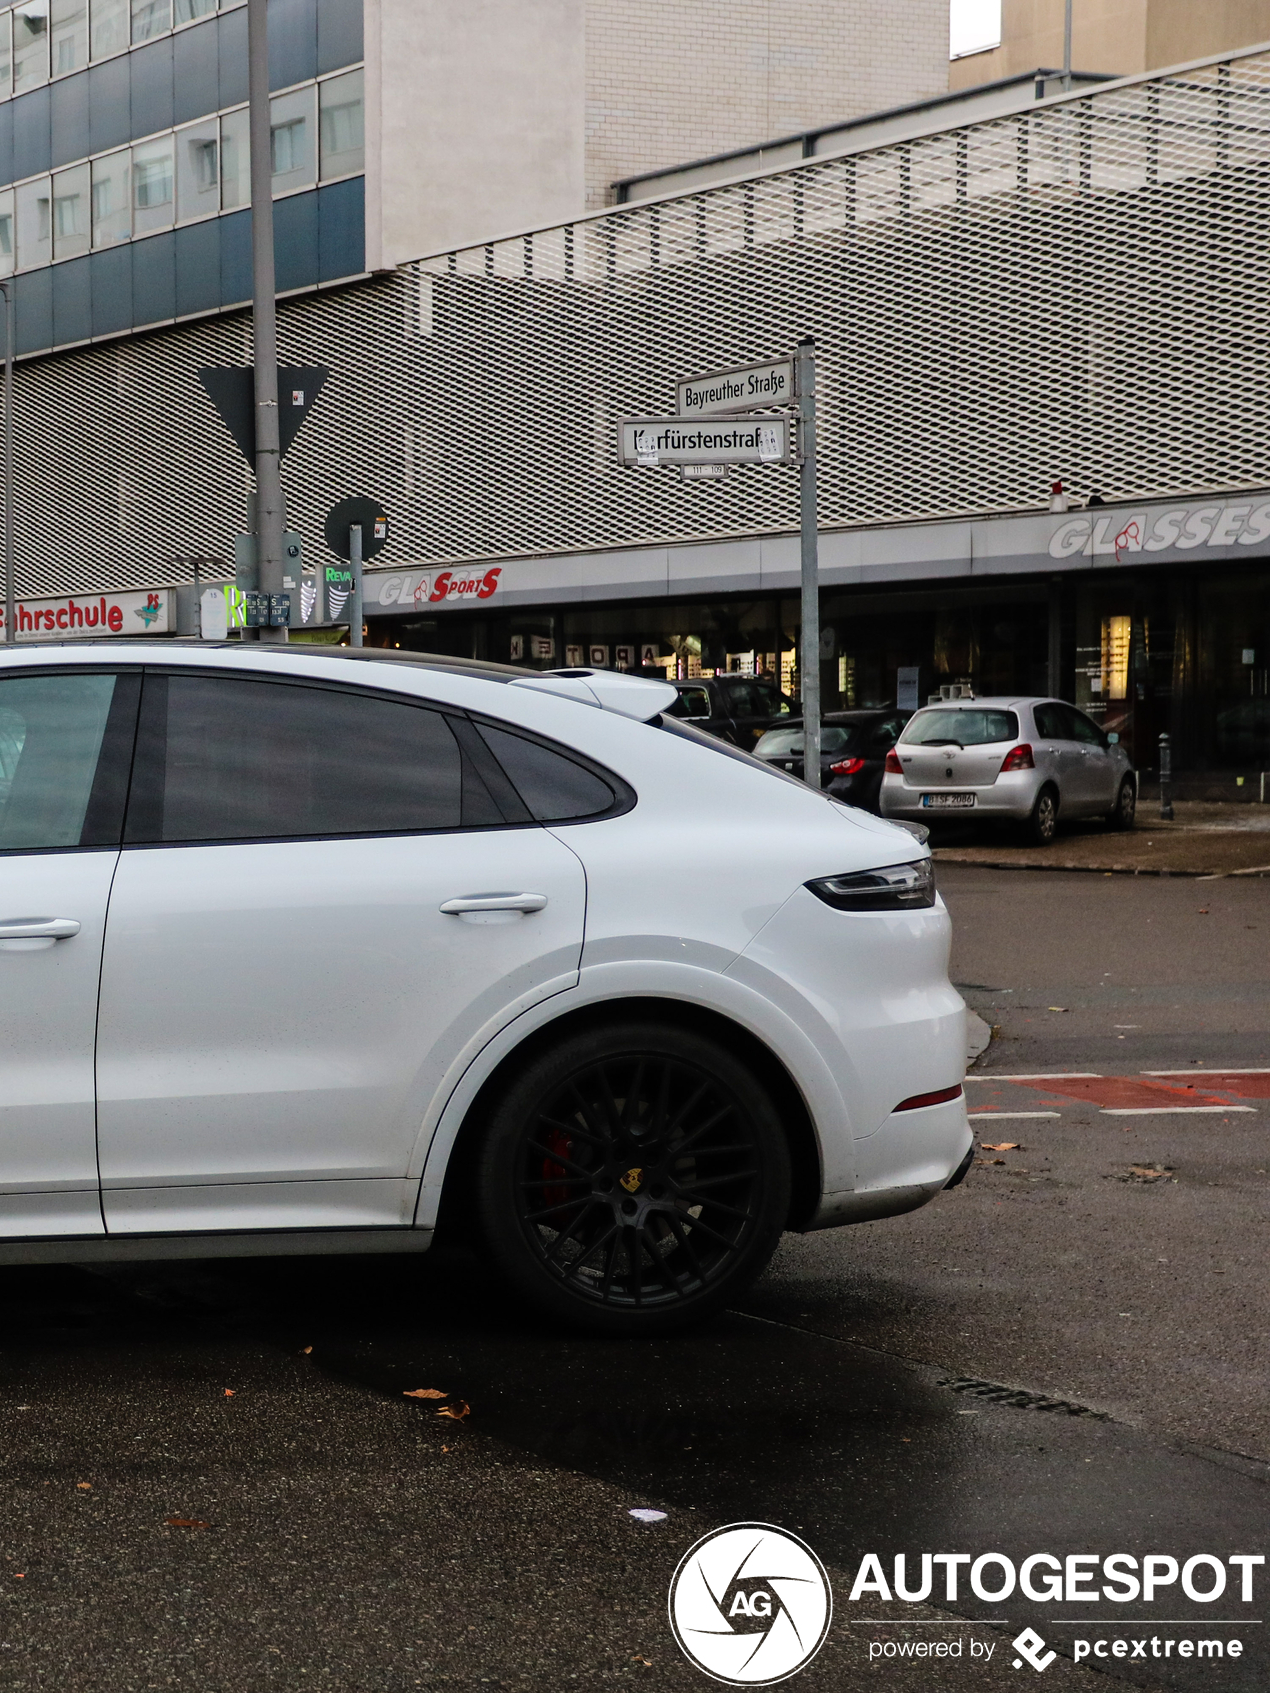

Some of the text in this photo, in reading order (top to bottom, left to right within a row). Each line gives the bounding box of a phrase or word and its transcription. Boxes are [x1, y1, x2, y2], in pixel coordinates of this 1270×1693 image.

[685, 370, 785, 409] Bayreuther Straße
[633, 427, 763, 450] Krfürstenstra
[692, 466, 703, 474] 111
[711, 465, 723, 474] 109
[1048, 503, 1270, 559] GLASSES
